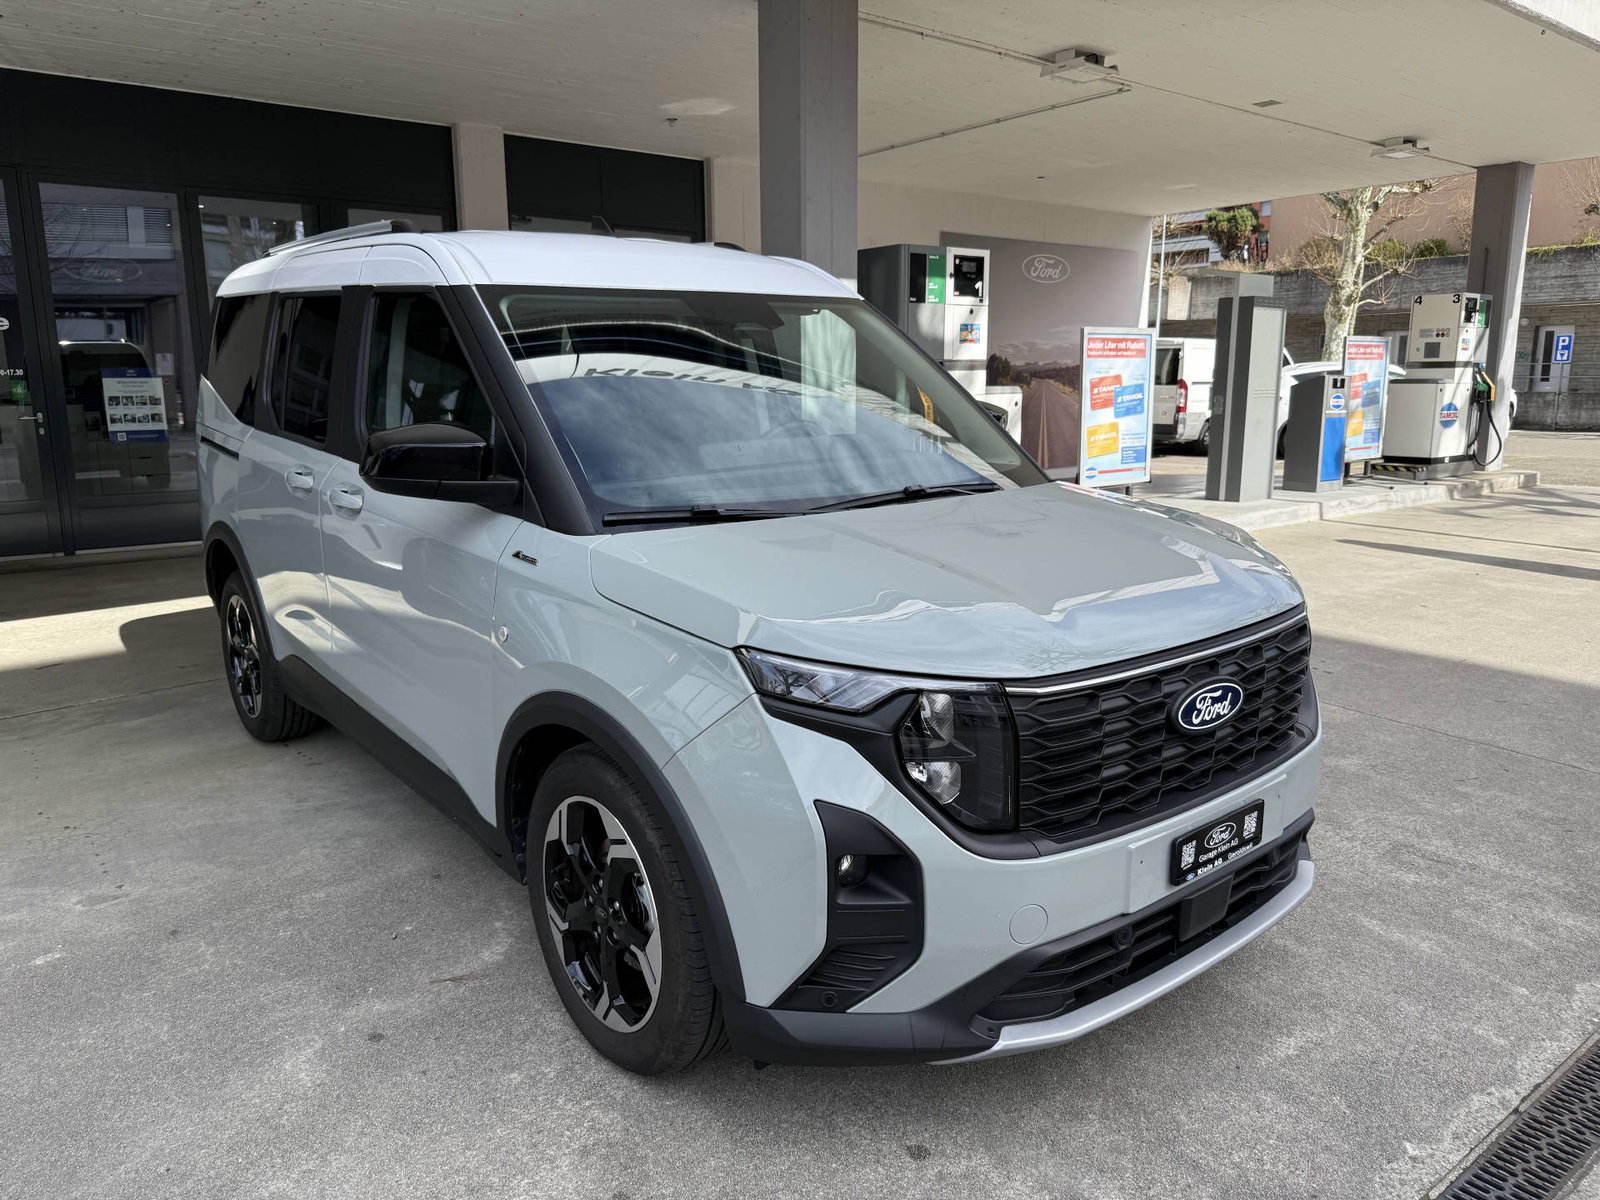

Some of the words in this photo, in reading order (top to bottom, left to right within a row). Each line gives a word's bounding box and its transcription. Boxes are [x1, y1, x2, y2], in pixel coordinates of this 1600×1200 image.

[1031, 257, 1062, 278] Ford
[974, 281, 983, 297] 1
[1414, 295, 1423, 305] 4
[1452, 293, 1460, 304] 3
[1088, 340, 1104, 349] Jeder
[1104, 340, 1117, 349] Liter
[1117, 341, 1126, 349] mit
[1558, 336, 1569, 350] P
[1440, 411, 1458, 419] TAMOIL
[1192, 689, 1232, 724] Ford
[1209, 826, 1231, 846] Ford
[1198, 848, 1218, 863] Garage
[1217, 842, 1231, 853] Klein
[1230, 837, 1239, 847] AG
[1197, 863, 1213, 875] Klein
[1213, 857, 1223, 867] AG
